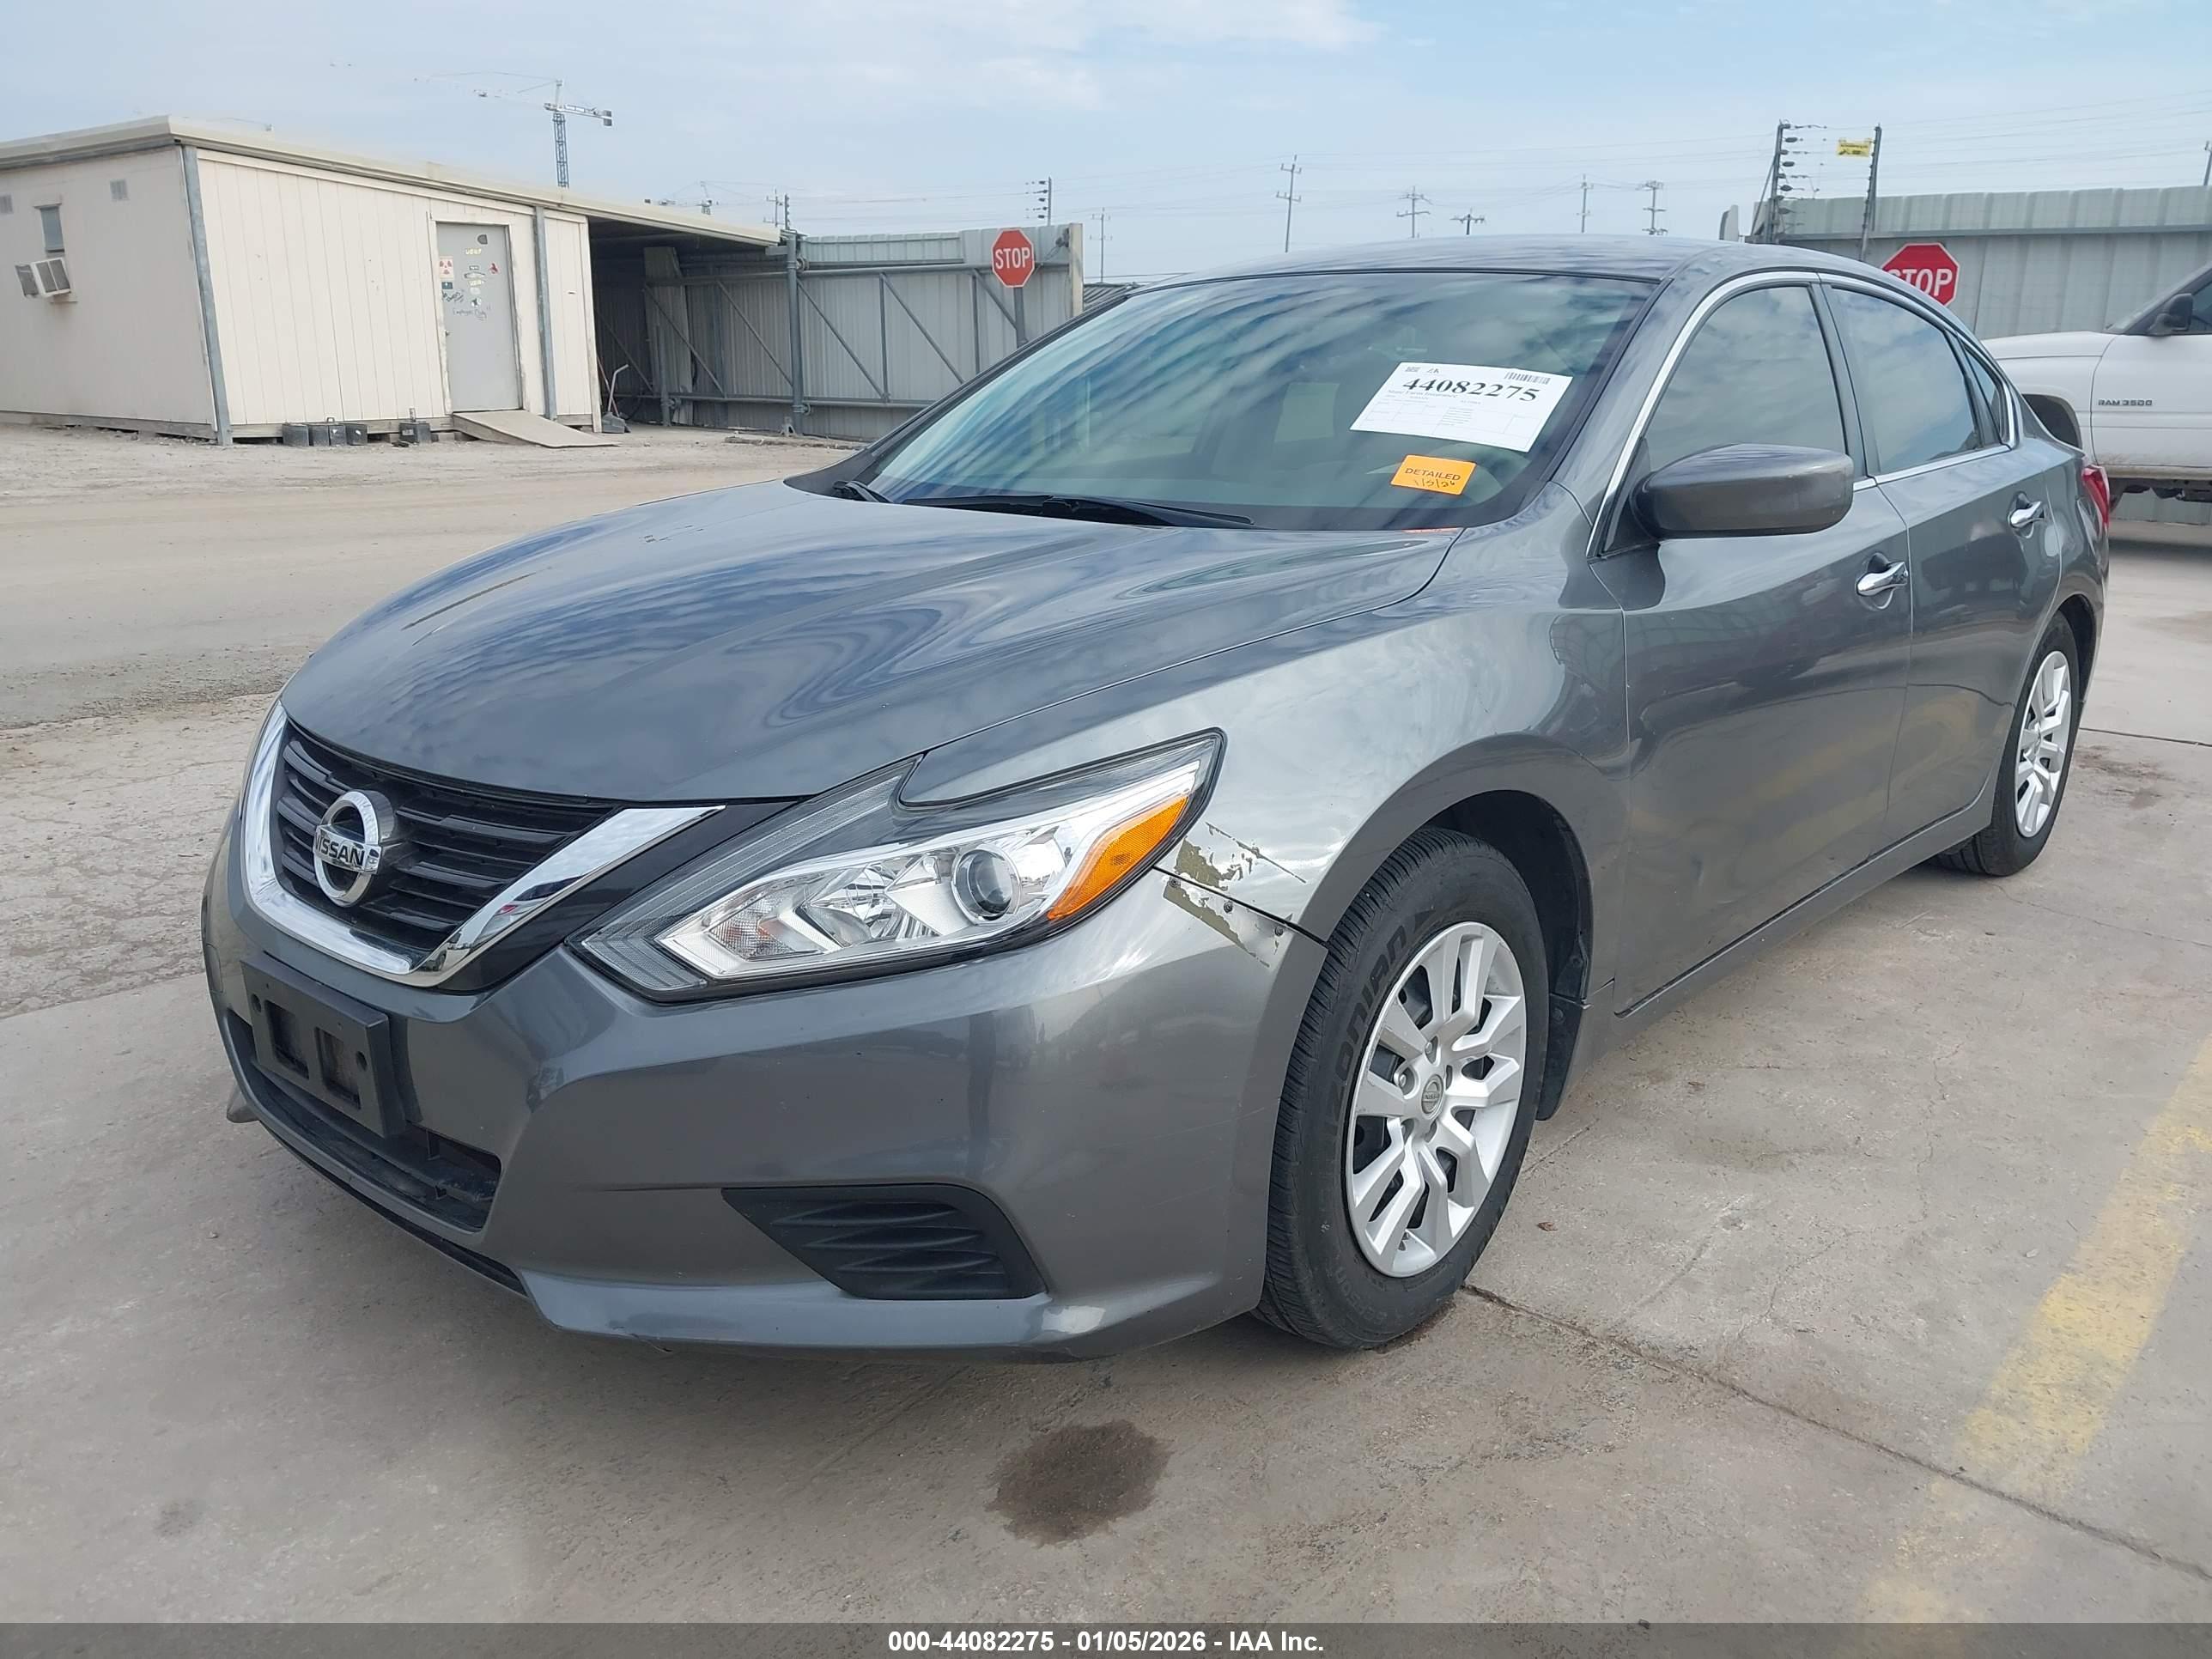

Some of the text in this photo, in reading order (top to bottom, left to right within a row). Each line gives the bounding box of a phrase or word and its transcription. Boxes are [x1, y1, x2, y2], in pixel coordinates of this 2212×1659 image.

[995, 246, 1030, 270] STOP
[1402, 378, 1541, 402] 44082275
[1404, 467, 1462, 481] DETAILED
[315, 835, 365, 866] NISSAN
